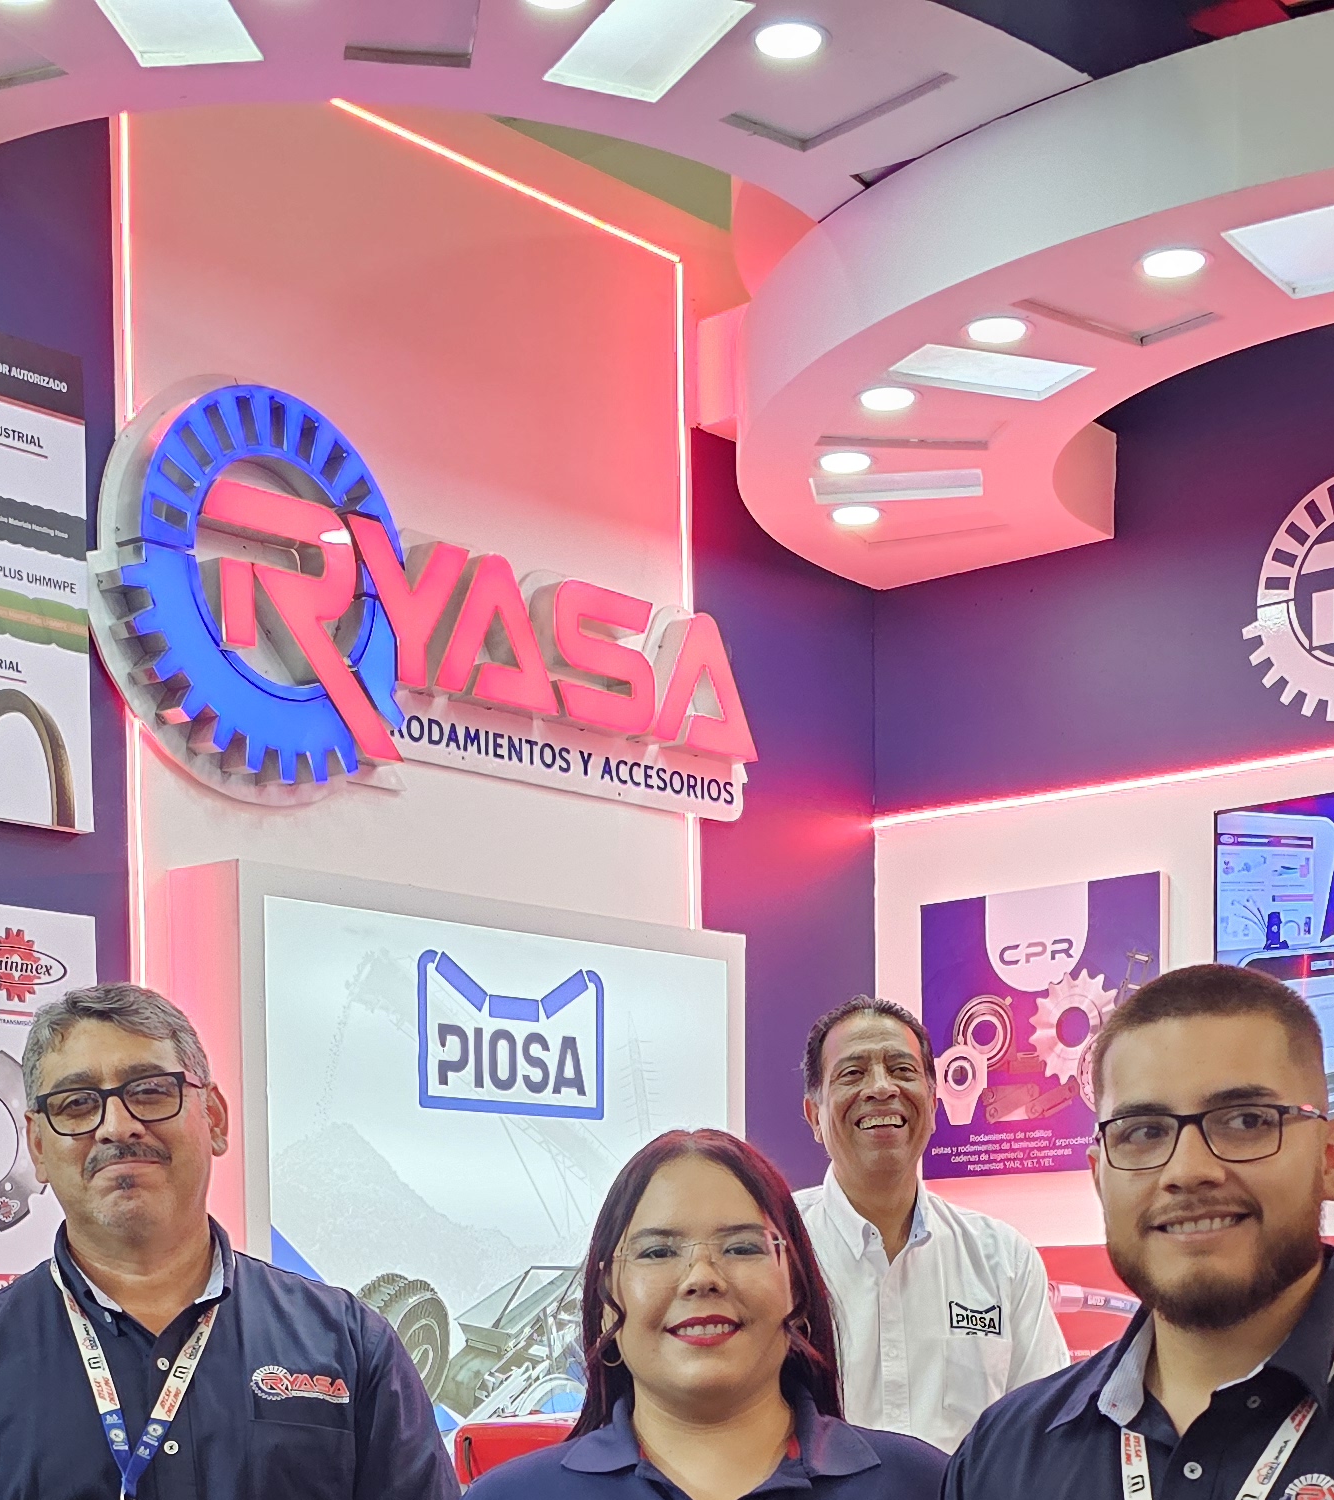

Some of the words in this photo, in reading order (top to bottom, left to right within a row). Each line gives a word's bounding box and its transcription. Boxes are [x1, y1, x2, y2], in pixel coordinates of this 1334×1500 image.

[11, 367, 68, 393] AUTORIZADO
[26, 572, 77, 594] UHMWPE
[202, 478, 760, 764] RYASA
[389, 714, 572, 775] RODAMIENTOS
[579, 747, 595, 777] Y
[601, 753, 735, 805] ACCESORIOS
[999, 938, 1074, 966] CPR
[0, 1018, 34, 1027] TRANSMISIÓ
[437, 1022, 588, 1098] PIOSA
[952, 1147, 957, 1155] y
[1001, 1142, 1010, 1150] de
[970, 1133, 1014, 1142] Rodamientos
[1016, 1131, 1024, 1139] de
[980, 1153, 989, 1161] de
[955, 1312, 997, 1331] PIOSA
[263, 1372, 348, 1398] RYASA
